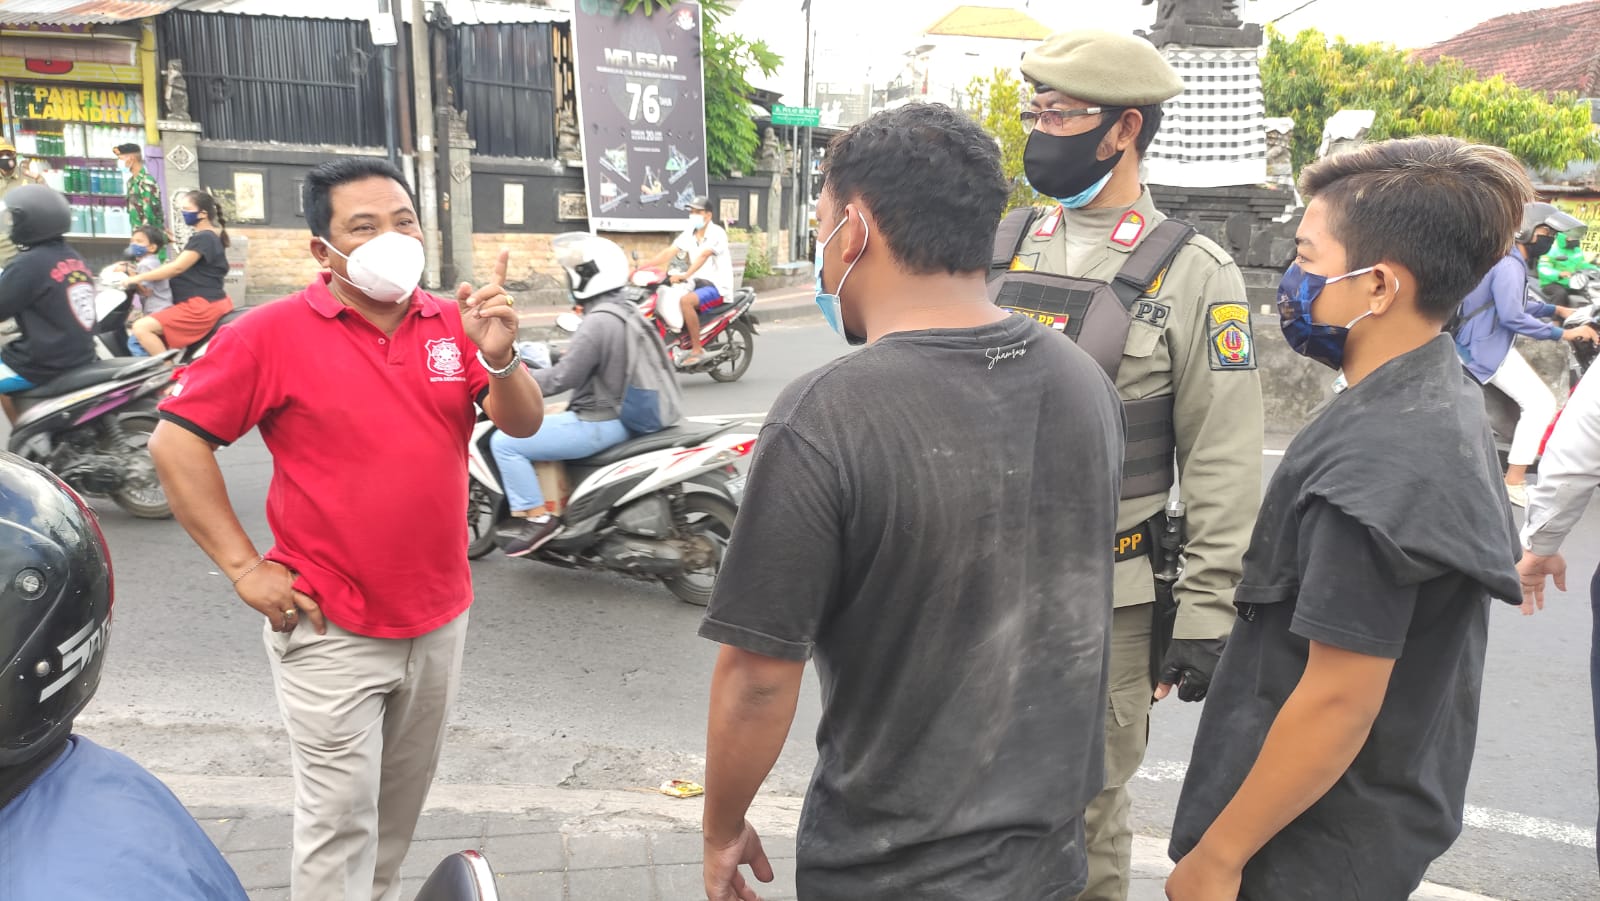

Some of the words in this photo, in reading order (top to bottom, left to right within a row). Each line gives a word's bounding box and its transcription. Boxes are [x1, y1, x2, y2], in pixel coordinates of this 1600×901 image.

[34, 87, 125, 106] PARFUM
[626, 82, 660, 124] 76
[28, 103, 132, 124] LAUNDRY
[1135, 302, 1166, 323] PP
